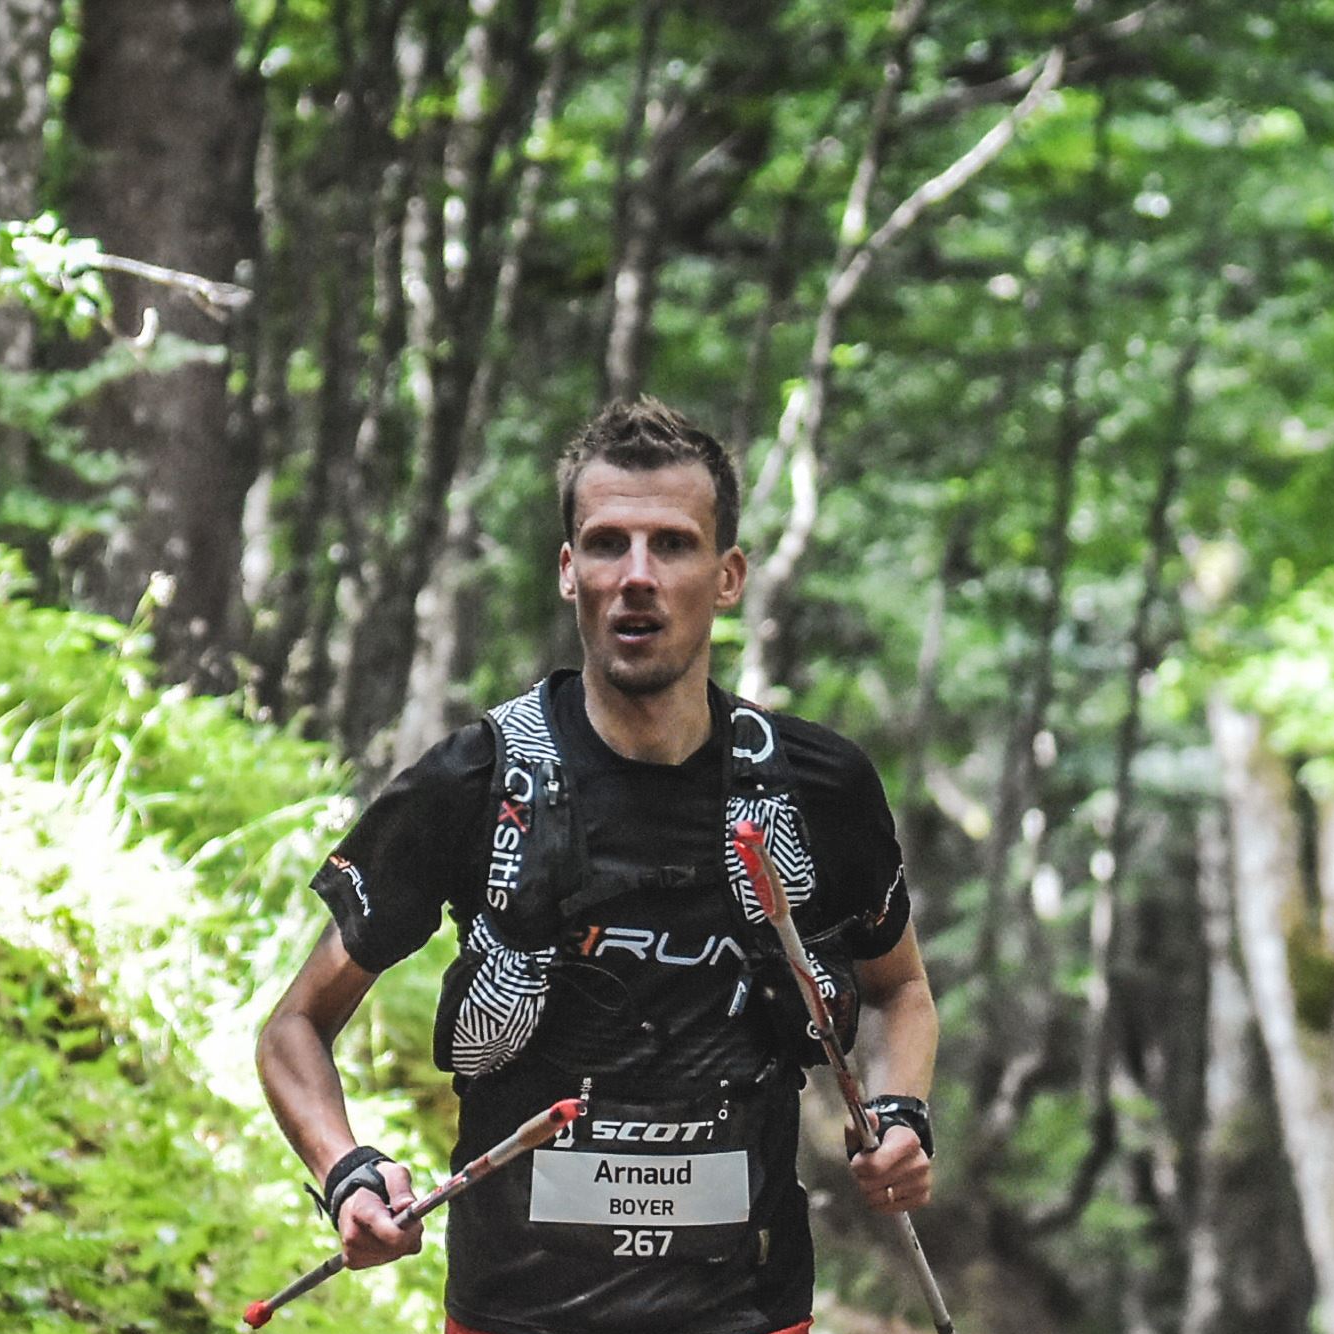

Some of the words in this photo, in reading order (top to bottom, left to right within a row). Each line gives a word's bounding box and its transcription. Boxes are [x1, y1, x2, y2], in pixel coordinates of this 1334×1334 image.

[594, 1160, 692, 1184] Arnaud
[609, 1199, 674, 1216] BOYER
[613, 1230, 673, 1256] 267
